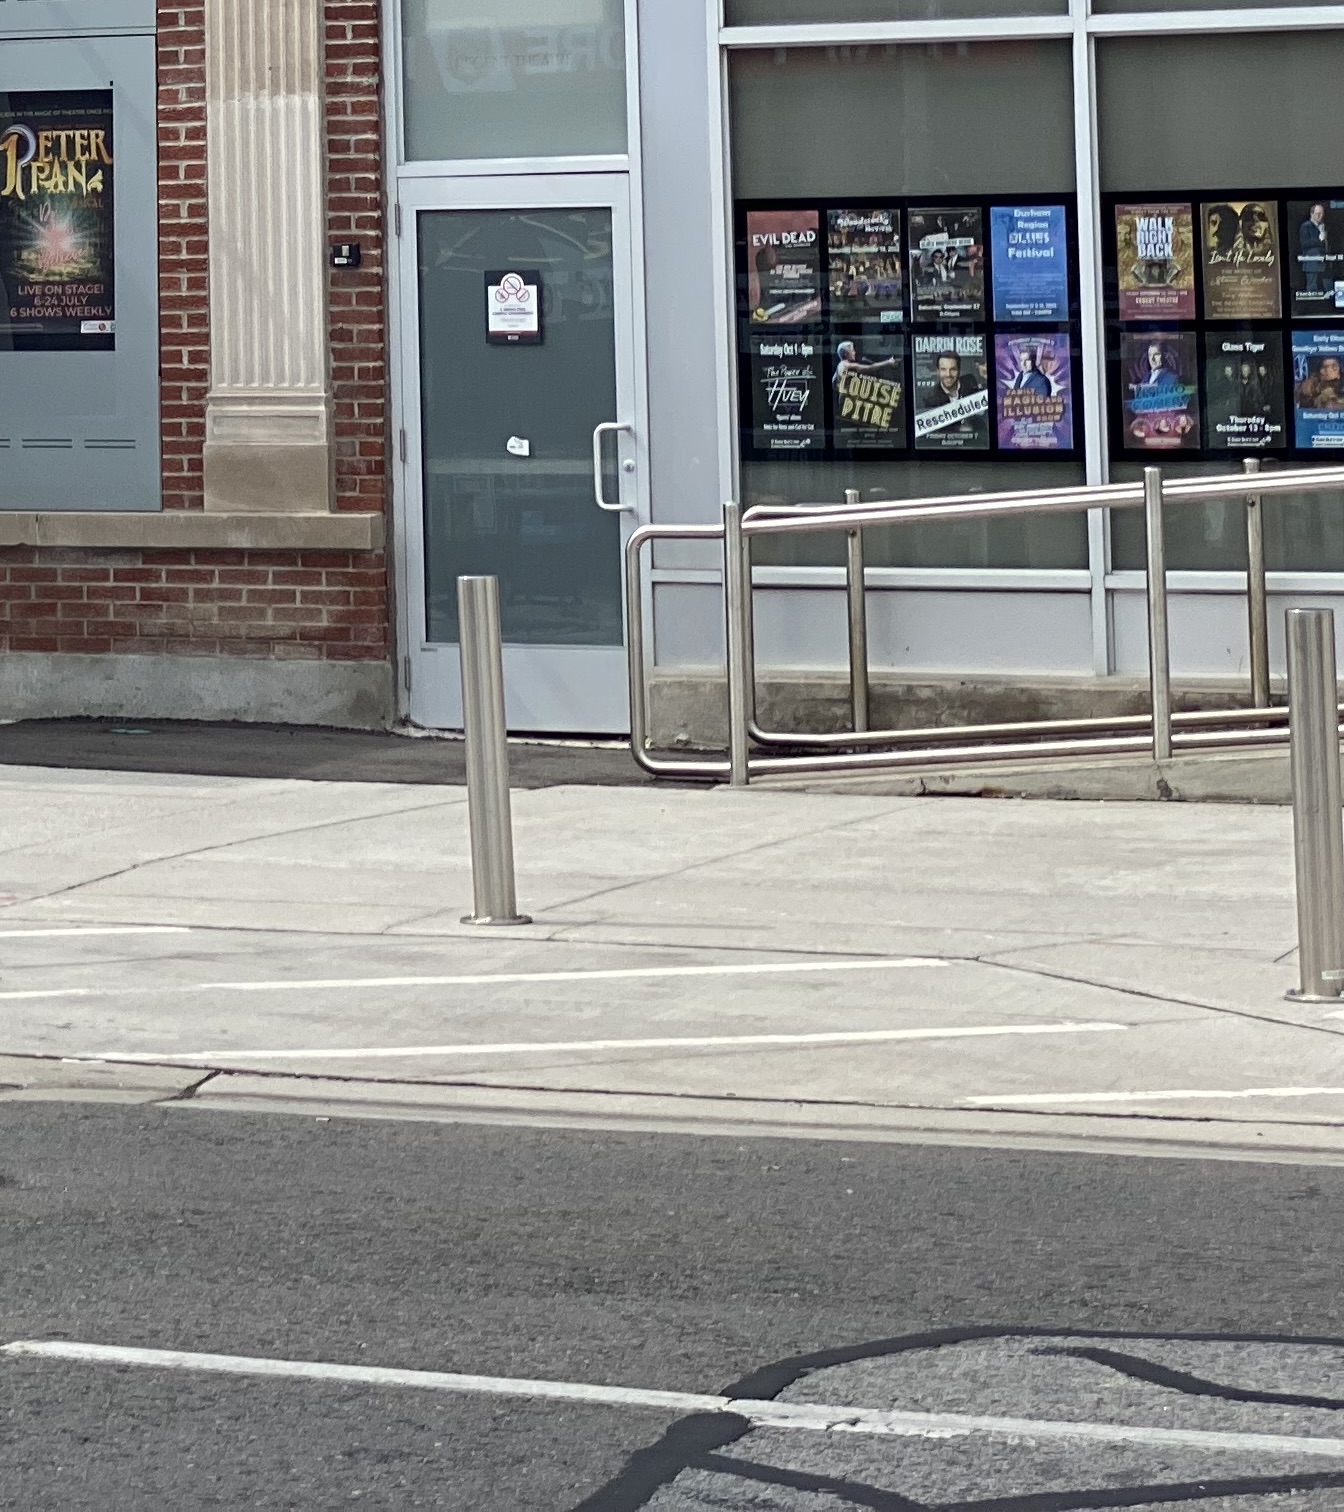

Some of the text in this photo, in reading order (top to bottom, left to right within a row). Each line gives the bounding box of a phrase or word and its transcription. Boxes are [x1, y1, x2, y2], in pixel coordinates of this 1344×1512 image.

[1135, 216, 1174, 232] WALK
[752, 230, 817, 247] EVIL DEAD
[1136, 230, 1173, 244] RIGHT
[1137, 243, 1174, 258] BACK
[17, 283, 105, 296] LIVE ON STAGE!
[60, 295, 89, 306] JULY
[19, 307, 63, 318] SHOWS
[64, 306, 113, 317] WEEKLY
[760, 343, 783, 359] Saturday
[915, 336, 984, 354] DARRIN ROSE
[838, 371, 902, 407] LOUISE
[841, 397, 894, 428] PITRE
[916, 395, 988, 432] Rescheduled
[1003, 405, 1064, 417] ILLUSION
